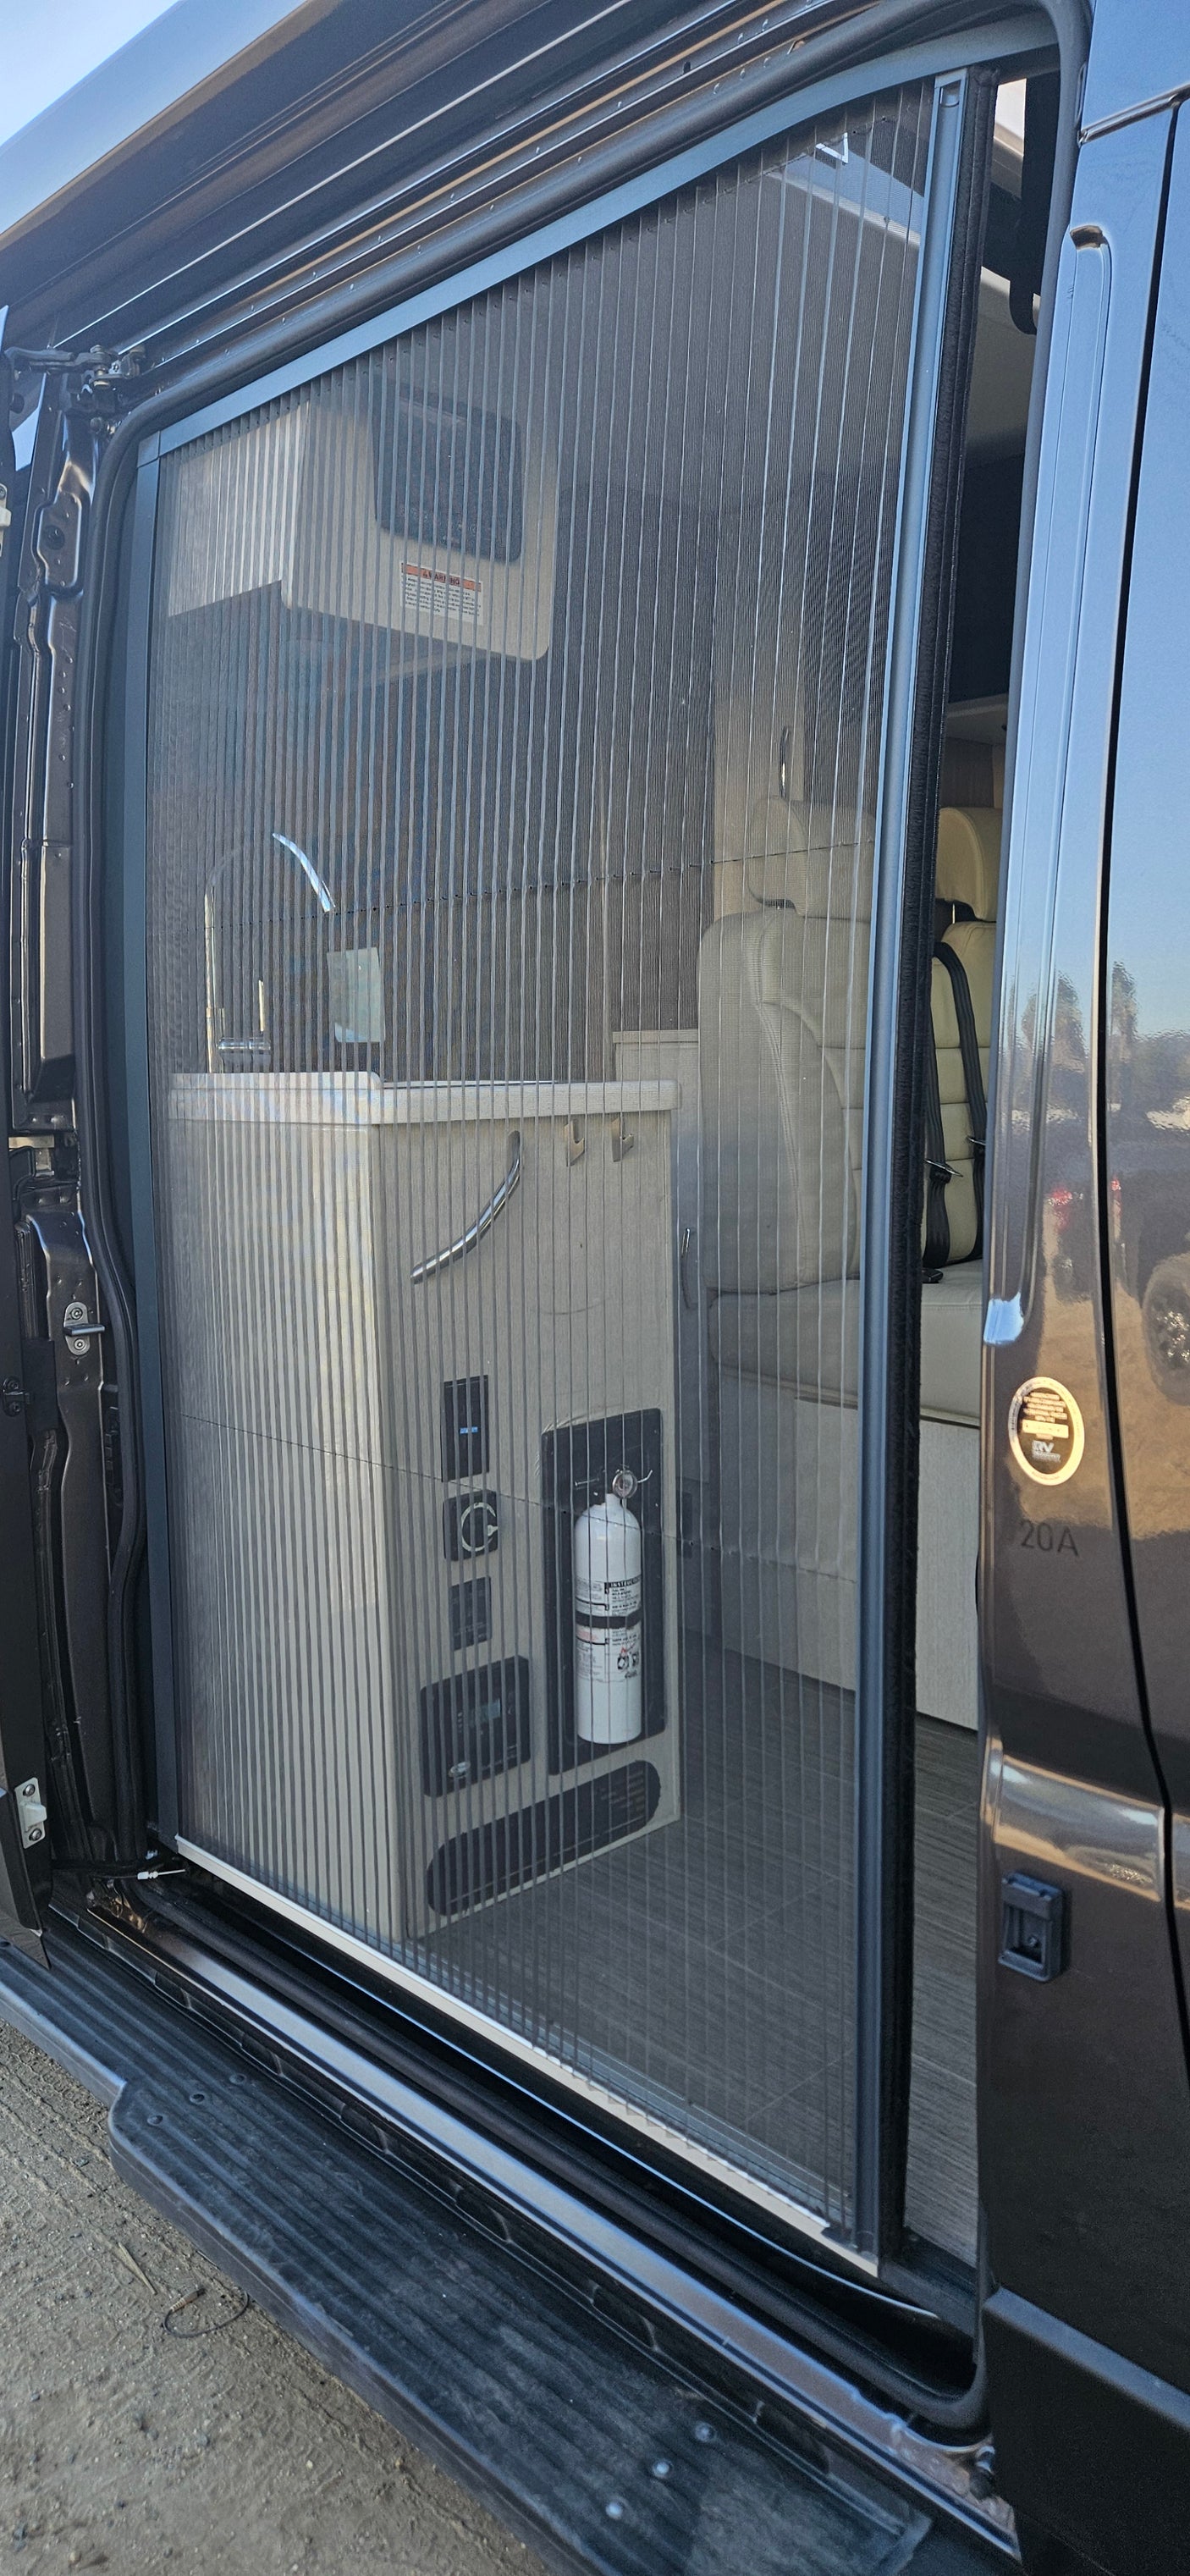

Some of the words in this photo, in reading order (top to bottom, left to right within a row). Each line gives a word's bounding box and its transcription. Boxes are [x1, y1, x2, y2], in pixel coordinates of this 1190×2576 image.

[428, 571, 460, 585] WARNG
[1032, 1440, 1055, 1453] RV
[1019, 1520, 1079, 1557] 20A
